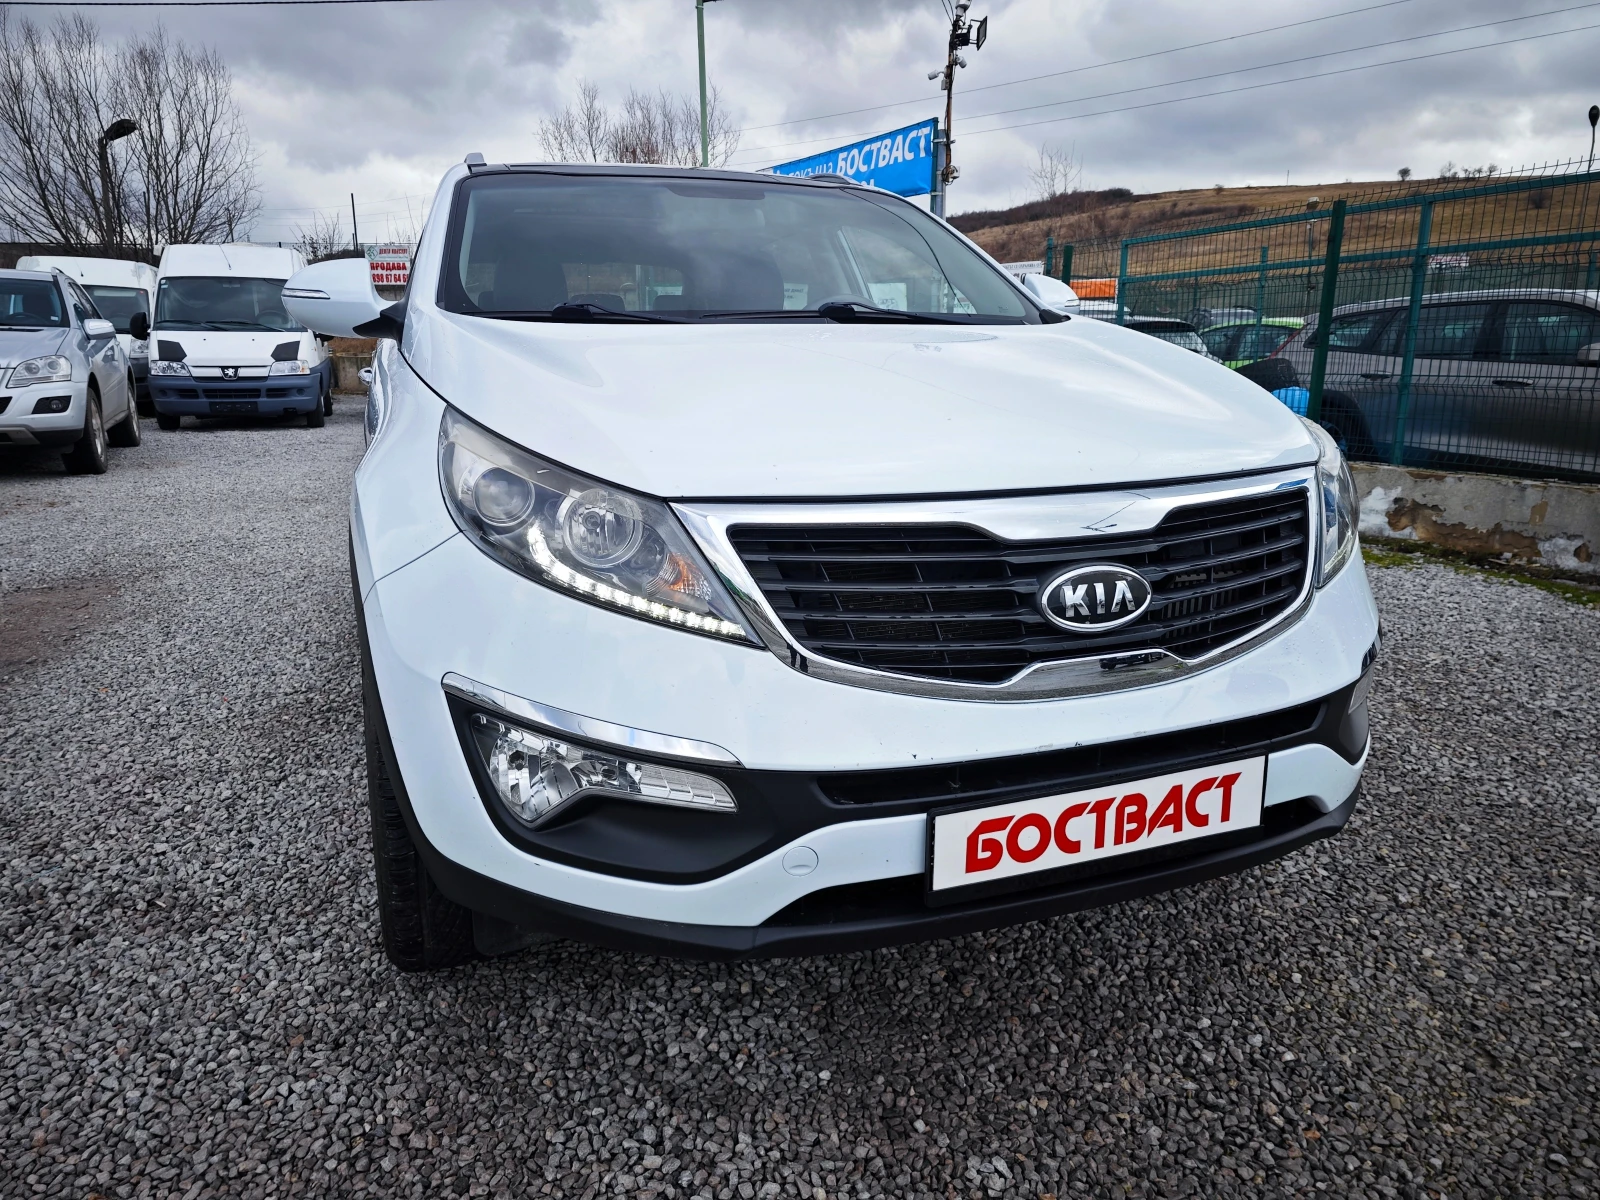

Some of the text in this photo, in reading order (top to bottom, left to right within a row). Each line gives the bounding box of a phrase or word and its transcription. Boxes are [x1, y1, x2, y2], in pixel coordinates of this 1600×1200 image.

[836, 126, 931, 176] БОСТВАСТ
[370, 262, 406, 272] ПРОДАВА
[1061, 580, 1136, 618] KIA
[964, 771, 1243, 875] БОСТВАСТ
